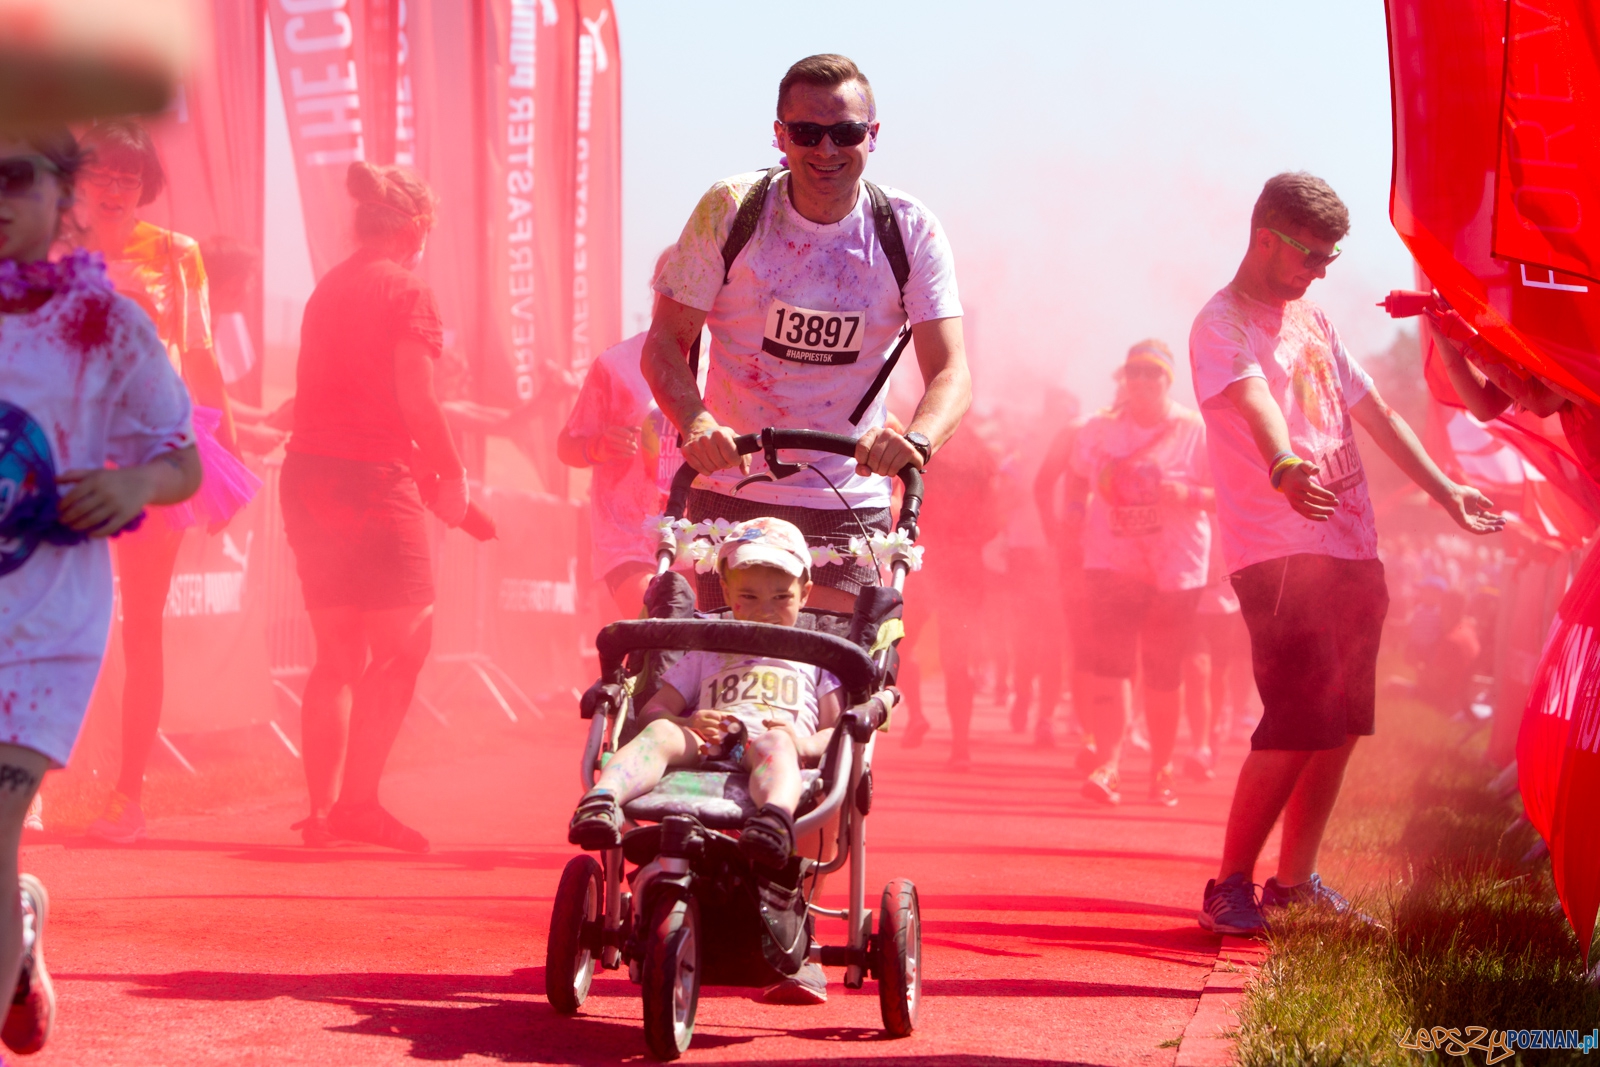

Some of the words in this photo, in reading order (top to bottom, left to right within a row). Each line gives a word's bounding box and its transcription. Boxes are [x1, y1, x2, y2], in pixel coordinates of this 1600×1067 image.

[774, 307, 860, 349] 13897
[786, 348, 834, 363] #HAPPIEST5K
[708, 671, 798, 709] 18290
